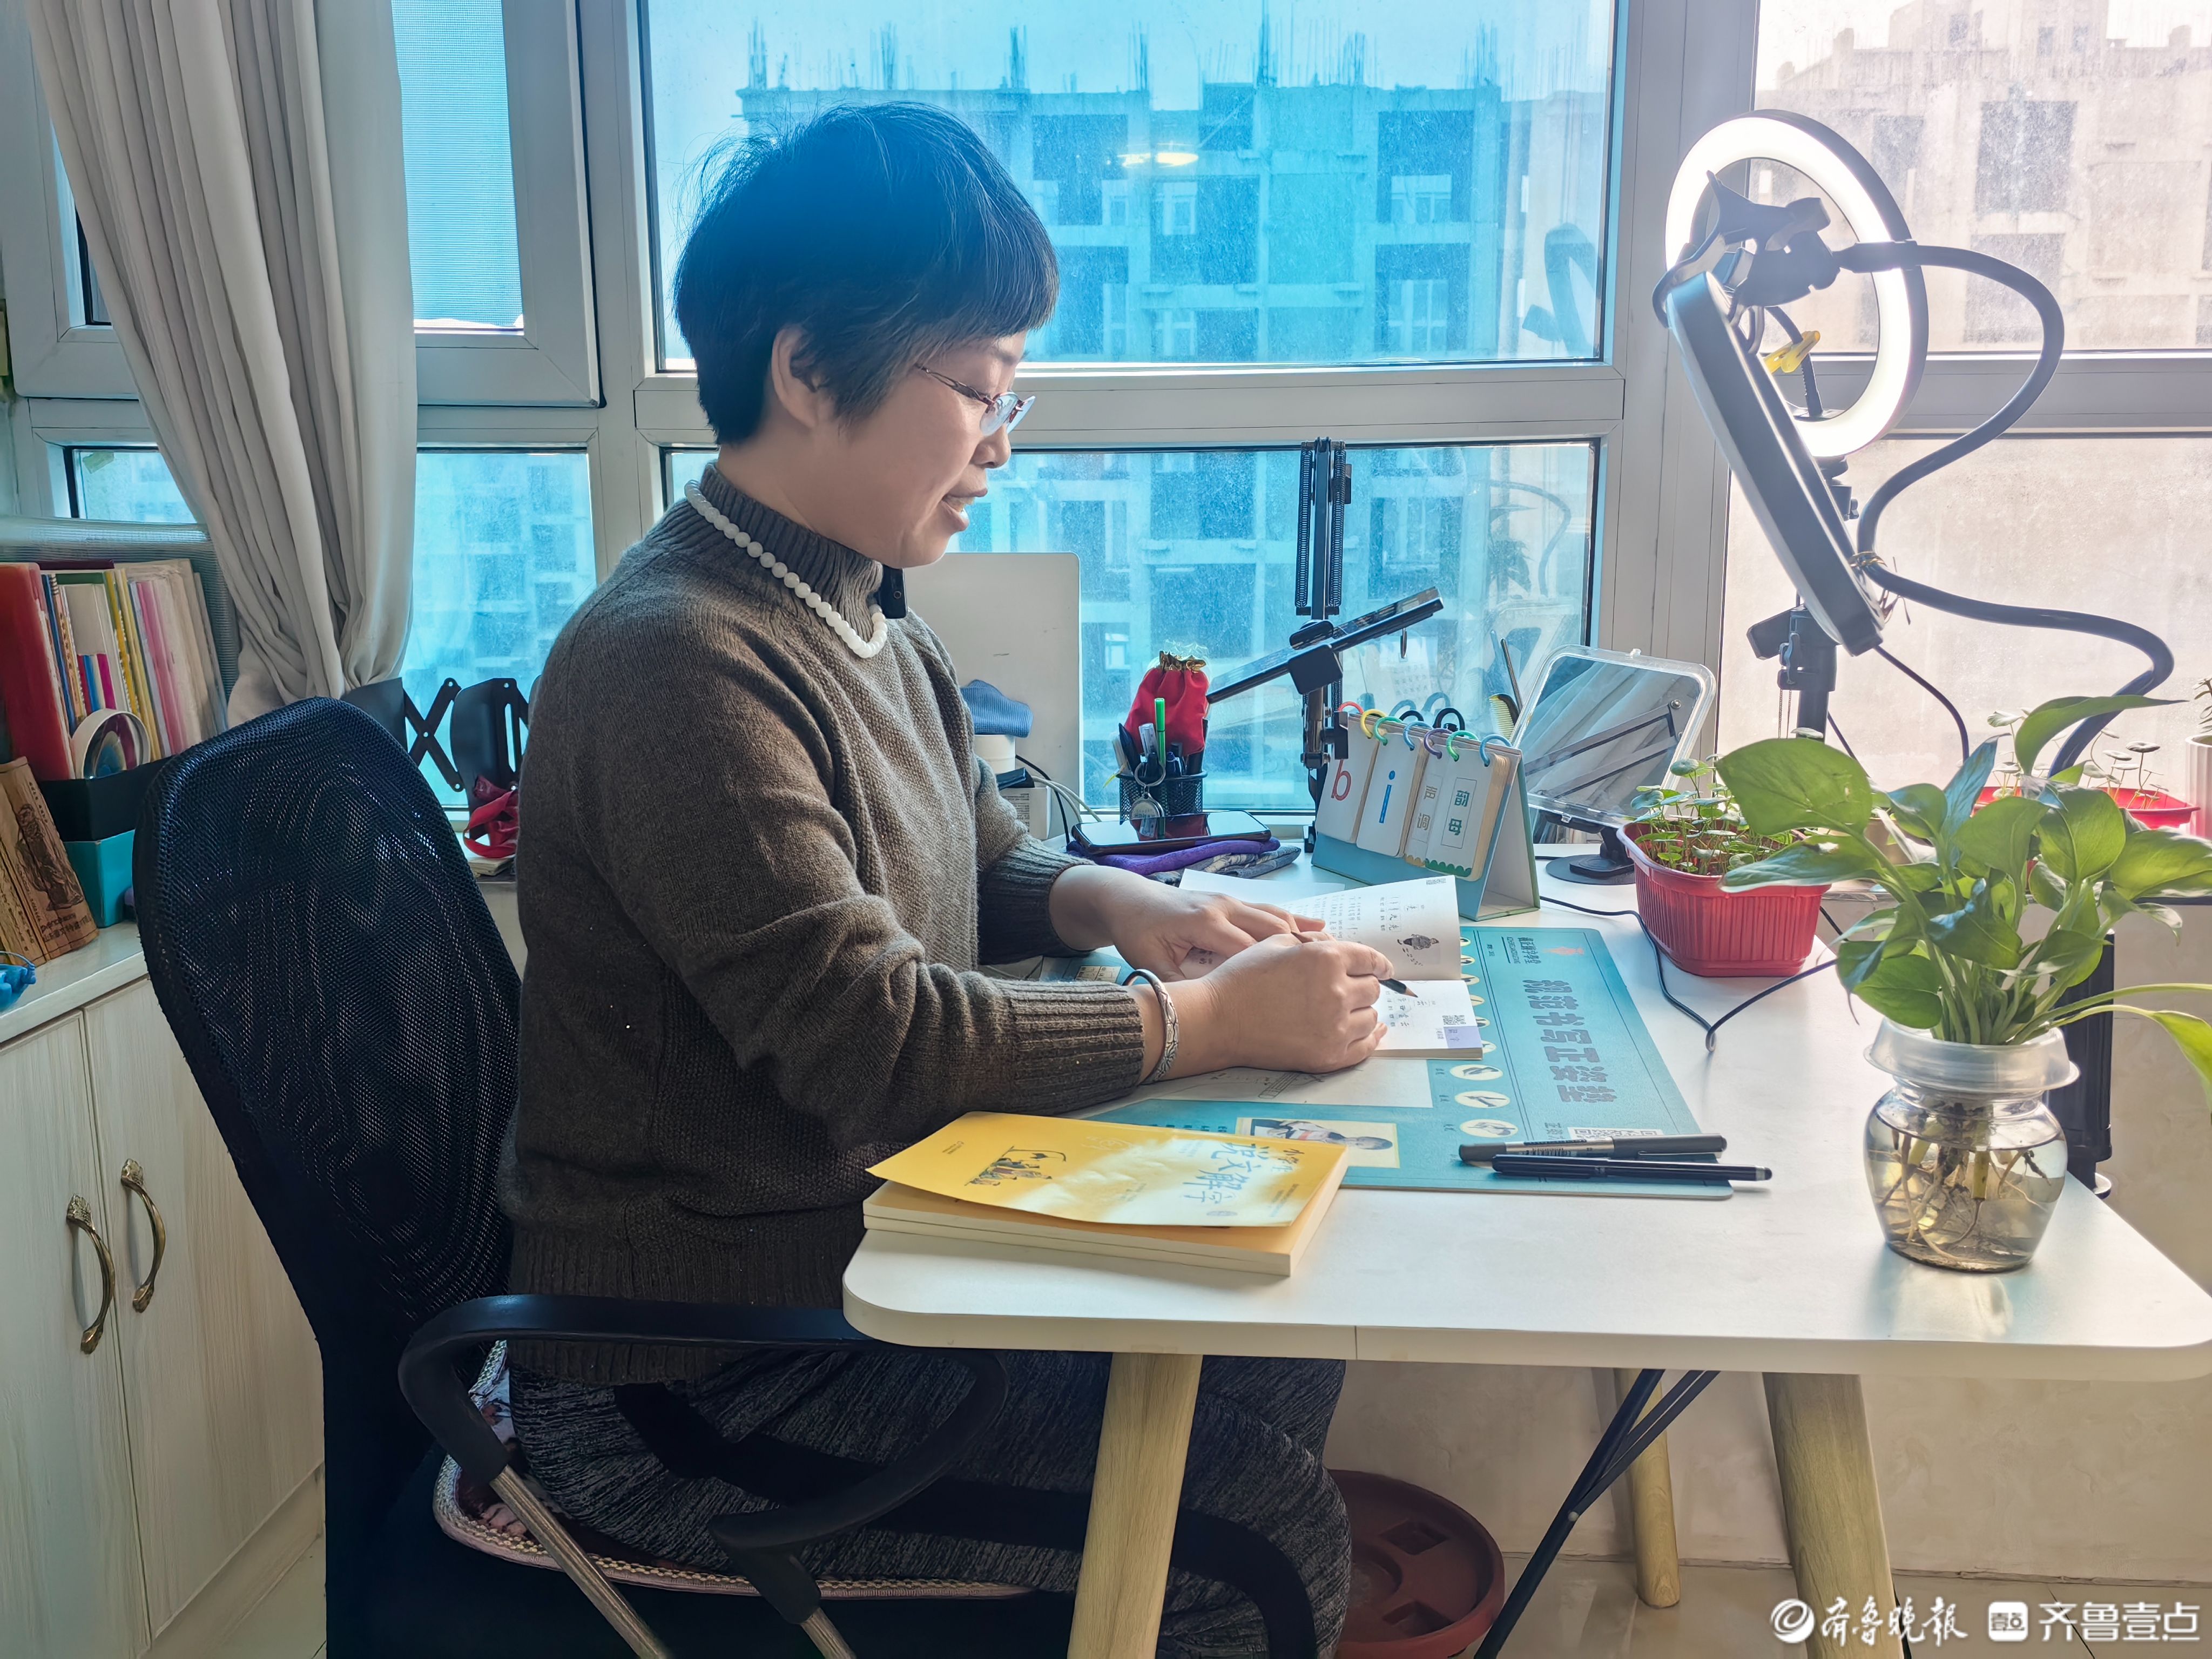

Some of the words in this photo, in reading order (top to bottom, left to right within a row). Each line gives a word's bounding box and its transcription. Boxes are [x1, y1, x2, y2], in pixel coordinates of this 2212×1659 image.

[1330, 757, 1352, 801] b
[1379, 770, 1396, 824] i
[1417, 785, 1438, 831] 声调
[1448, 790, 1470, 835] 韵母
[1522, 979, 1618, 1103] 规范书写正姿垫
[1182, 1143, 1270, 1204] 说文解字
[1271, 1148, 1305, 1172] 小学生
